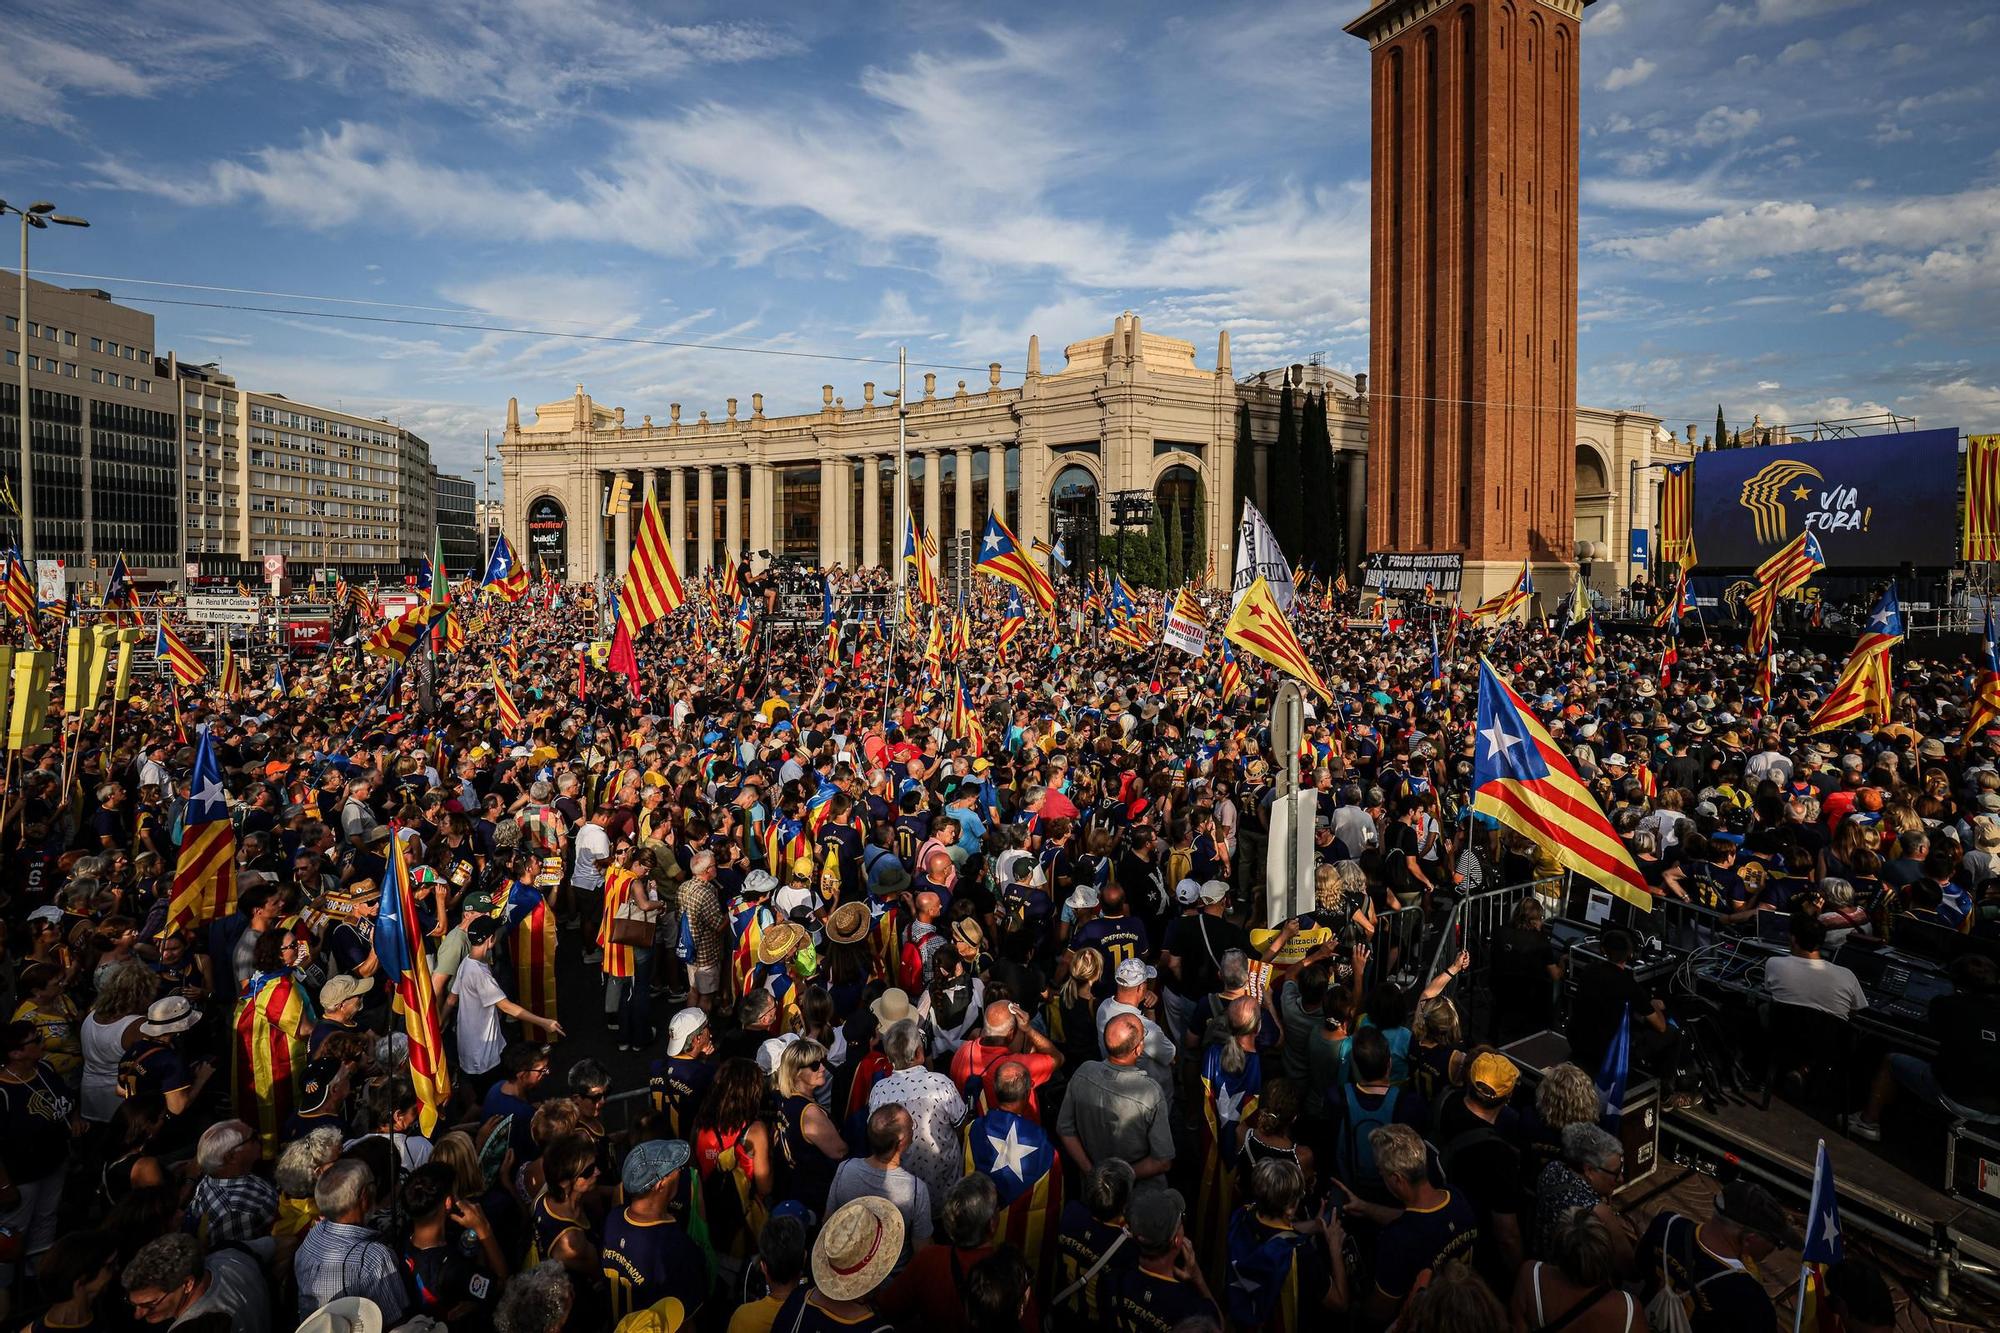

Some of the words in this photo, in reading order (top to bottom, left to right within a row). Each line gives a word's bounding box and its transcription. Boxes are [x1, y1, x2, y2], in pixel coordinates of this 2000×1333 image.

[1820, 483, 1858, 510] VIA
[1804, 506, 1872, 534] FORA!
[1387, 555, 1413, 567] PROU
[1413, 554, 1461, 569] MENTIDES,
[196, 611, 208, 619] Fira
[1169, 617, 1203, 640] AMNISTIA
[28, 869, 42, 886] 6
